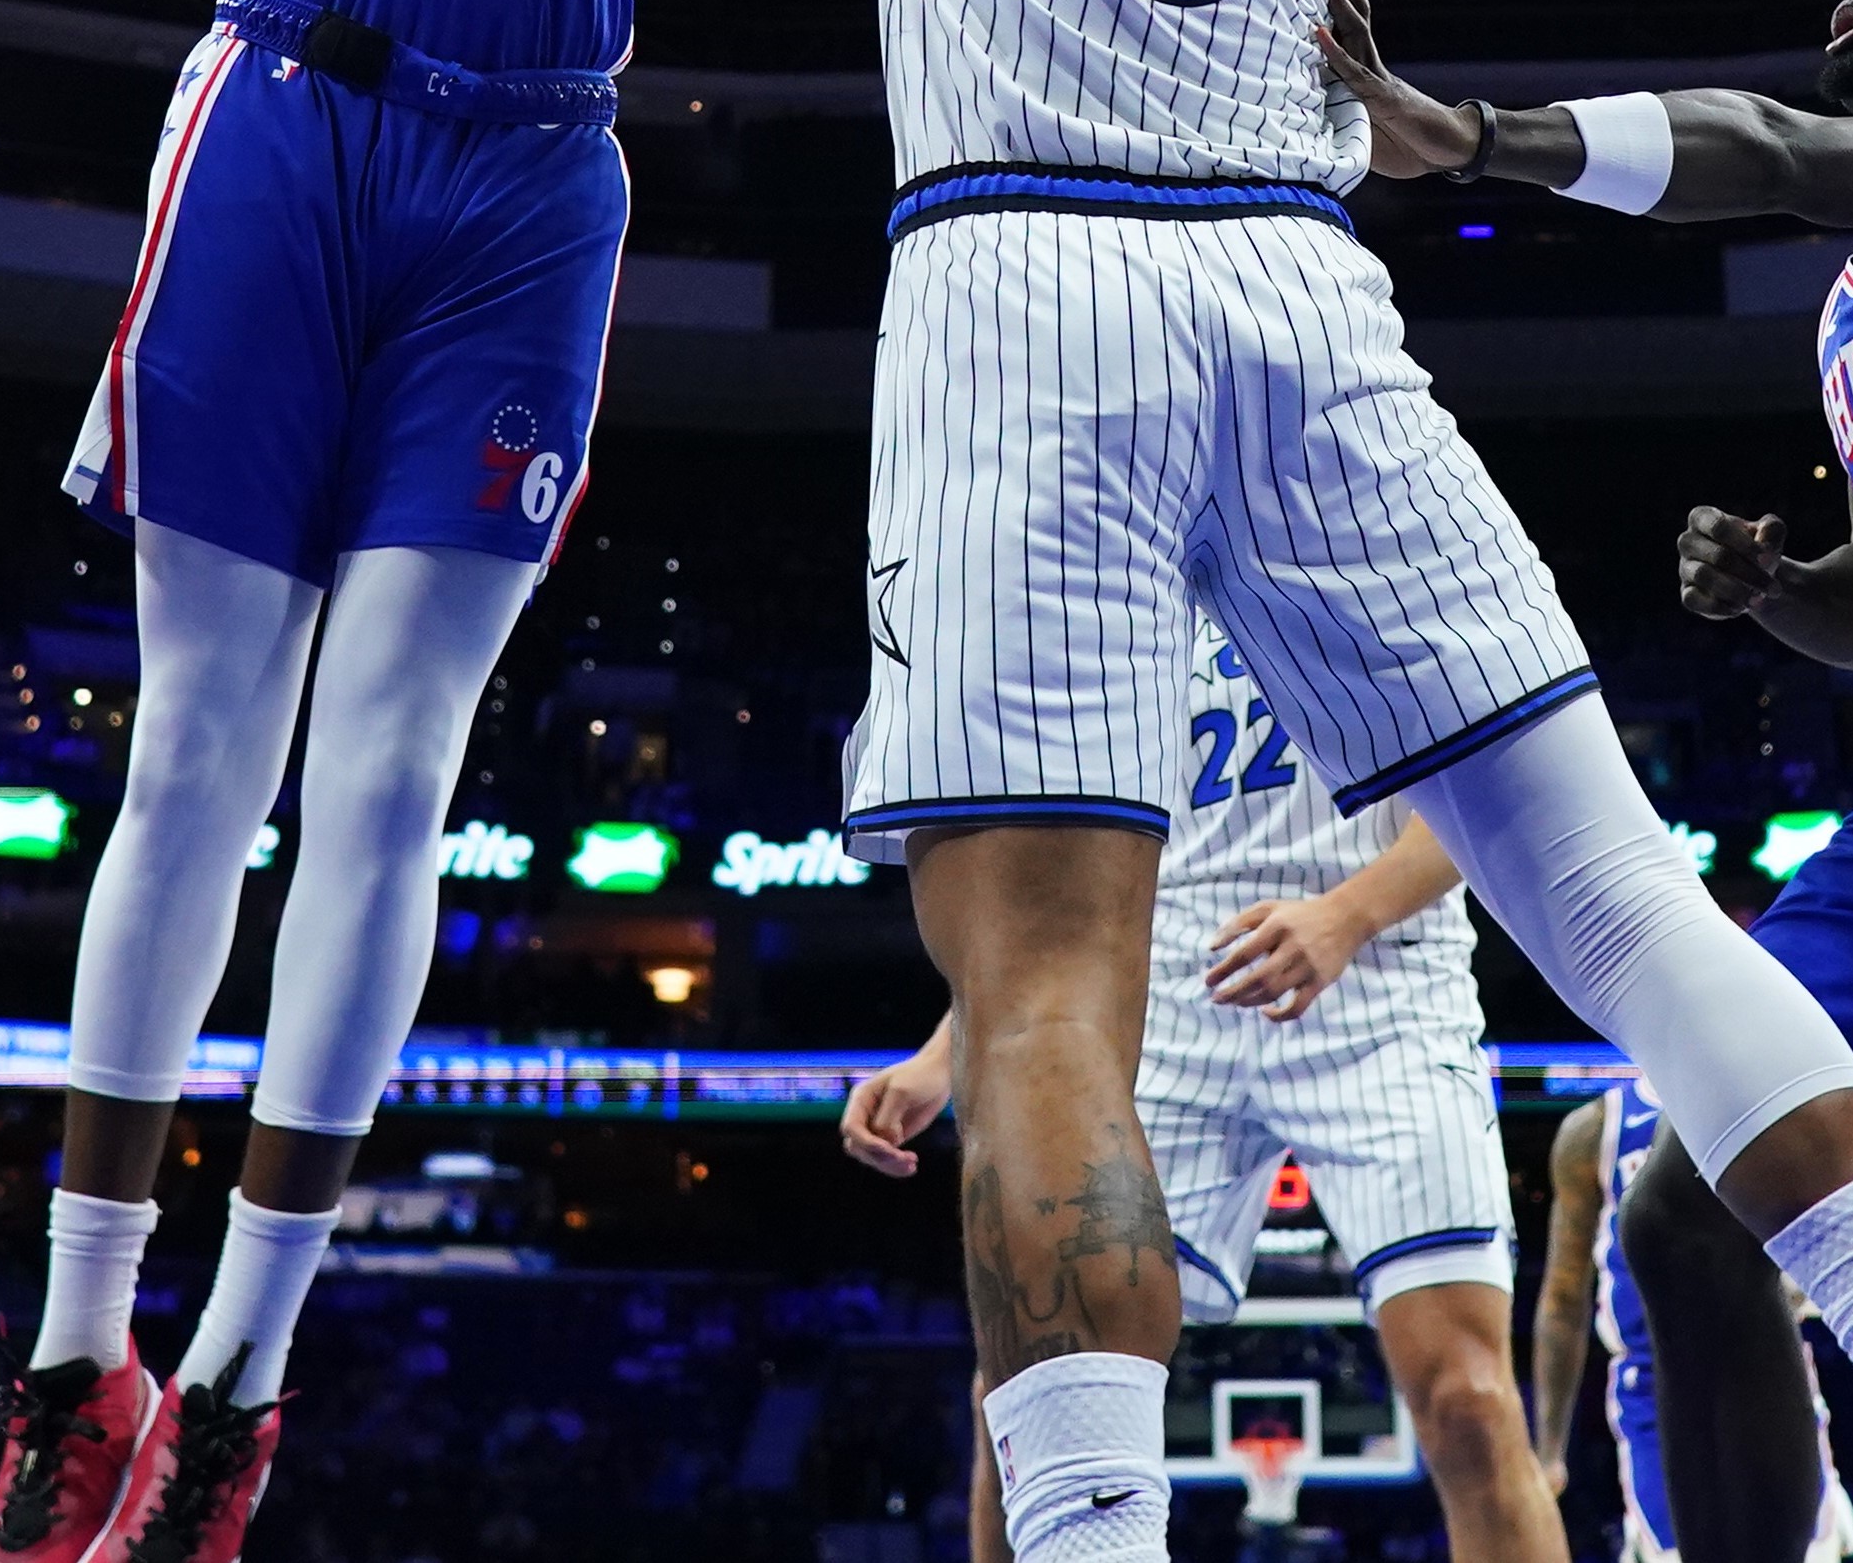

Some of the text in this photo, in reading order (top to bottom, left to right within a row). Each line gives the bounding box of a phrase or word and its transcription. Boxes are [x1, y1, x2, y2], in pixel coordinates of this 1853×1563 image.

[472, 436, 564, 526] 76
[1189, 698, 1297, 812] 22
[713, 829, 872, 896] Sprite
